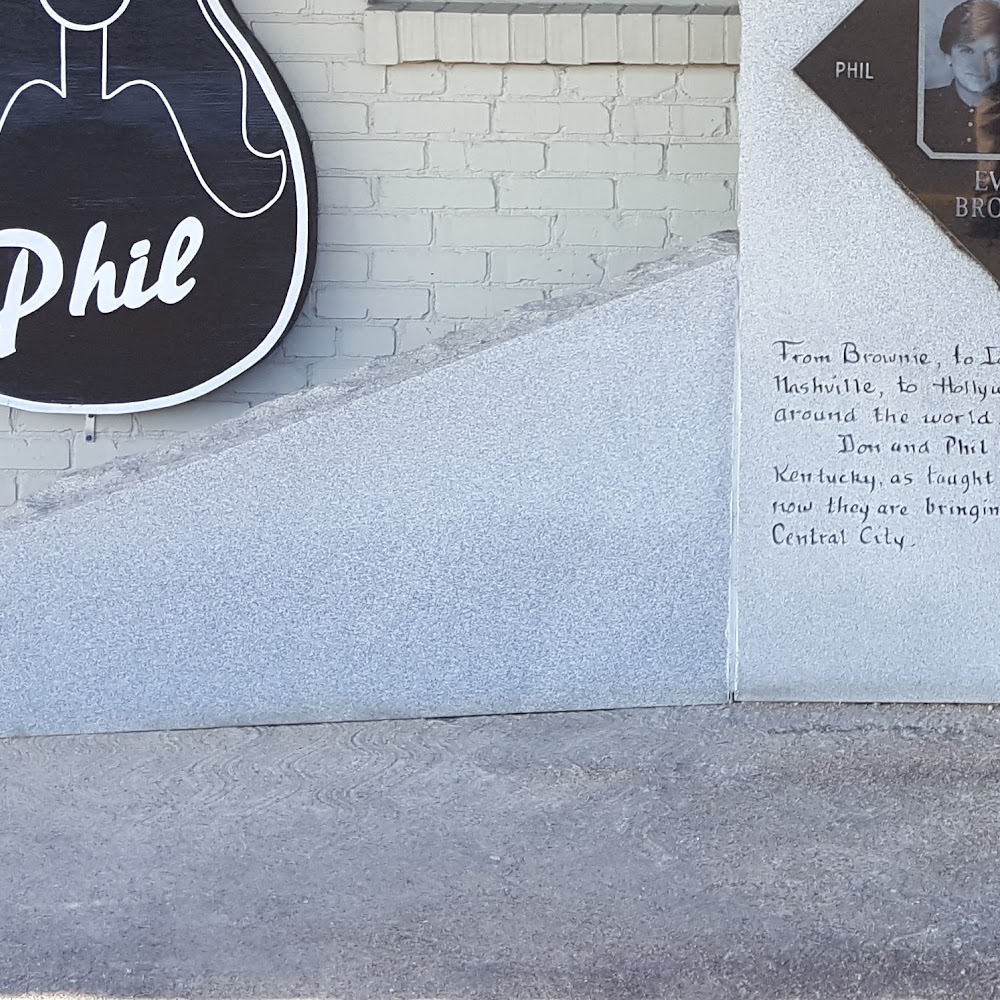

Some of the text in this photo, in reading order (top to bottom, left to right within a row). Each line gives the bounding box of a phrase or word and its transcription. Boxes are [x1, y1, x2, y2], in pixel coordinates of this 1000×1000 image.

[834, 61, 875, 81] PHIL
[0, 216, 204, 359] Phil
[772, 340, 831, 363] From
[841, 341, 941, 369] Brownie,
[954, 344, 973, 365] to
[774, 375, 883, 398] Nashville,
[896, 376, 917, 393] to
[774, 408, 857, 423] around
[873, 407, 908, 424] the
[838, 433, 880, 454] Don
[890, 440, 930, 454] and
[945, 435, 989, 455] Phil
[890, 474, 913, 486] as
[927, 465, 994, 493] taught
[772, 500, 813, 514] now
[827, 496, 870, 523] they
[877, 503, 910, 516] are
[771, 522, 848, 546] Central
